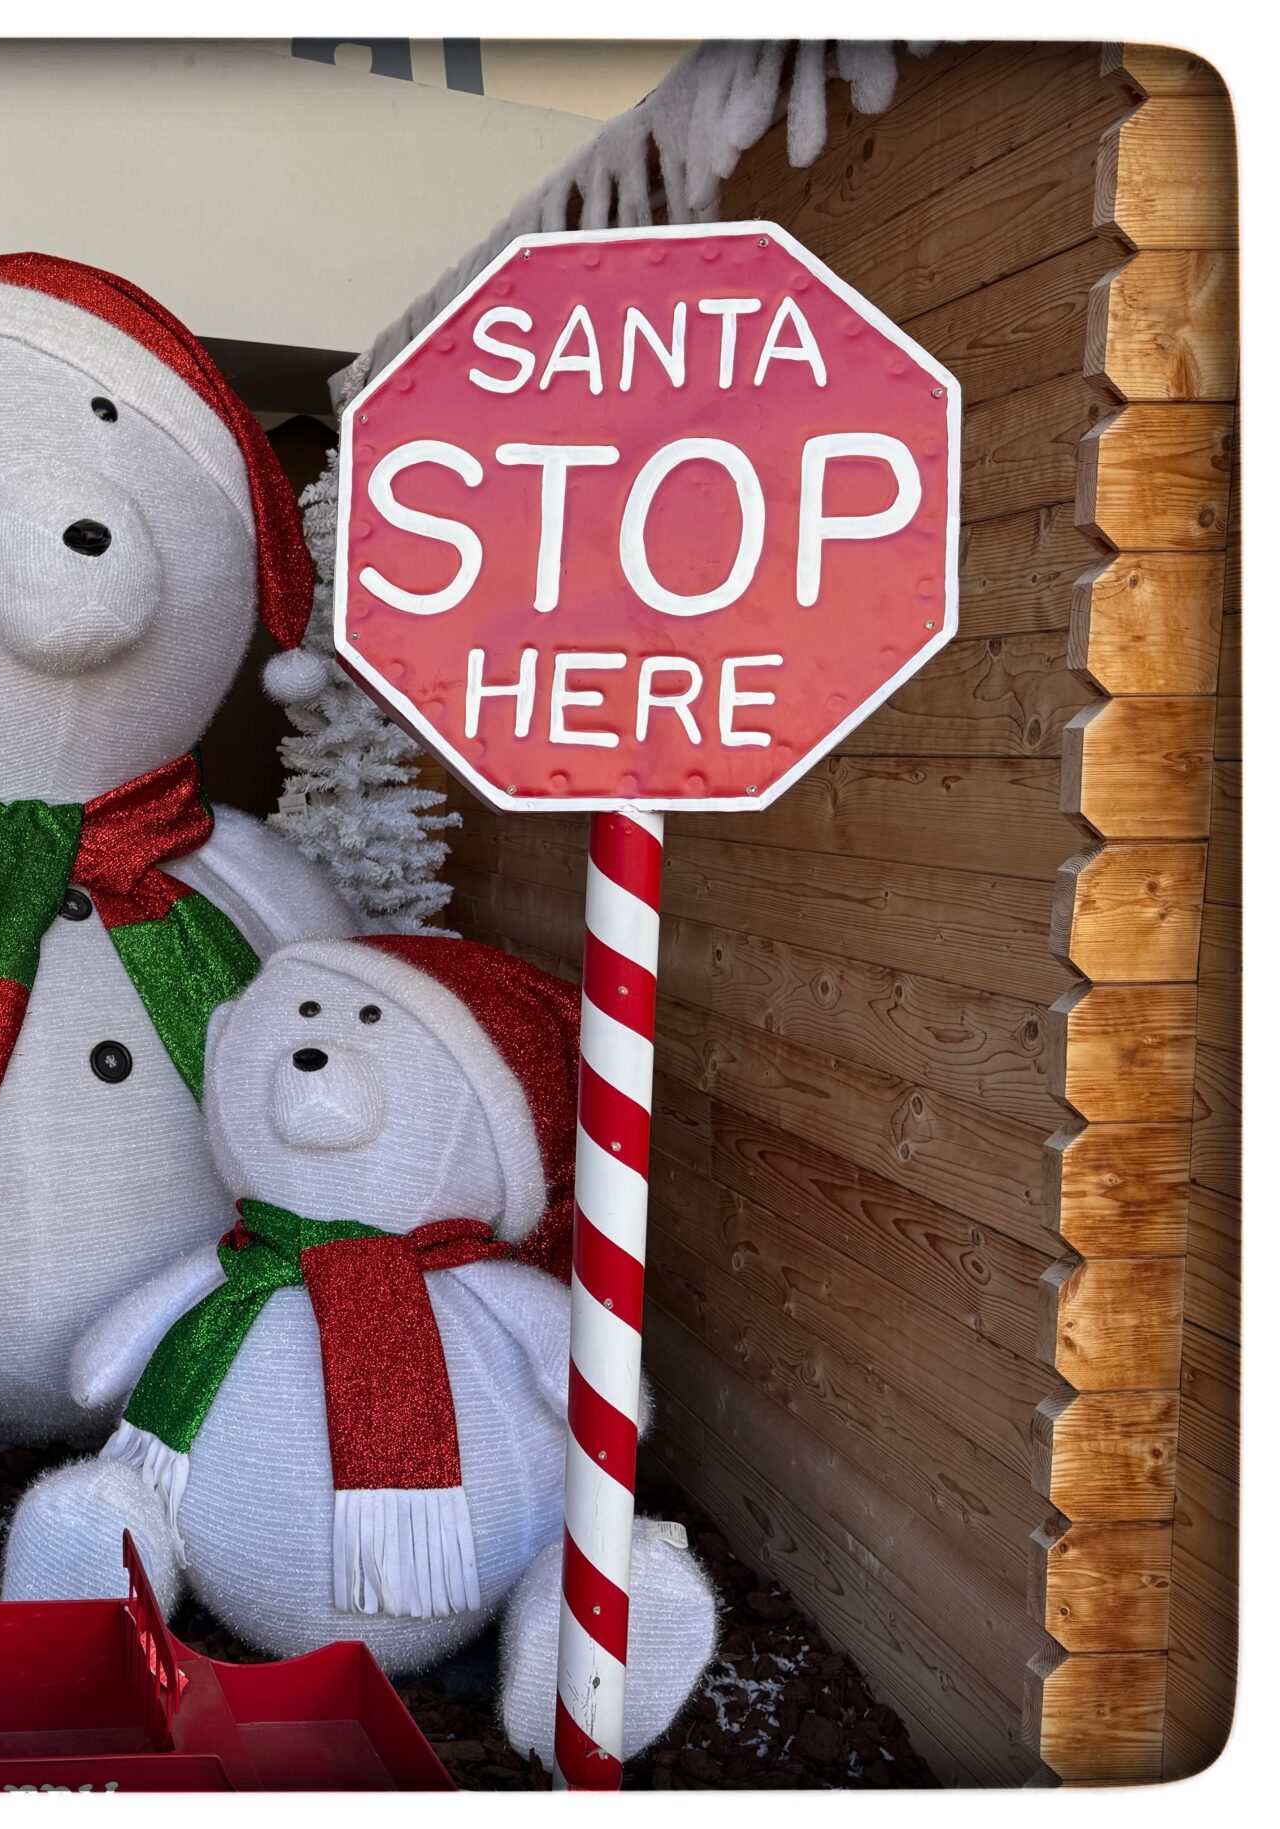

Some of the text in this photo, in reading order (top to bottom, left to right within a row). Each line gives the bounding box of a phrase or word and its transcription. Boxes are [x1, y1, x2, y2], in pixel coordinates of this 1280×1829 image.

[468, 296, 827, 395] SANTA
[359, 432, 922, 616] STOP
[464, 648, 784, 748] HERE
